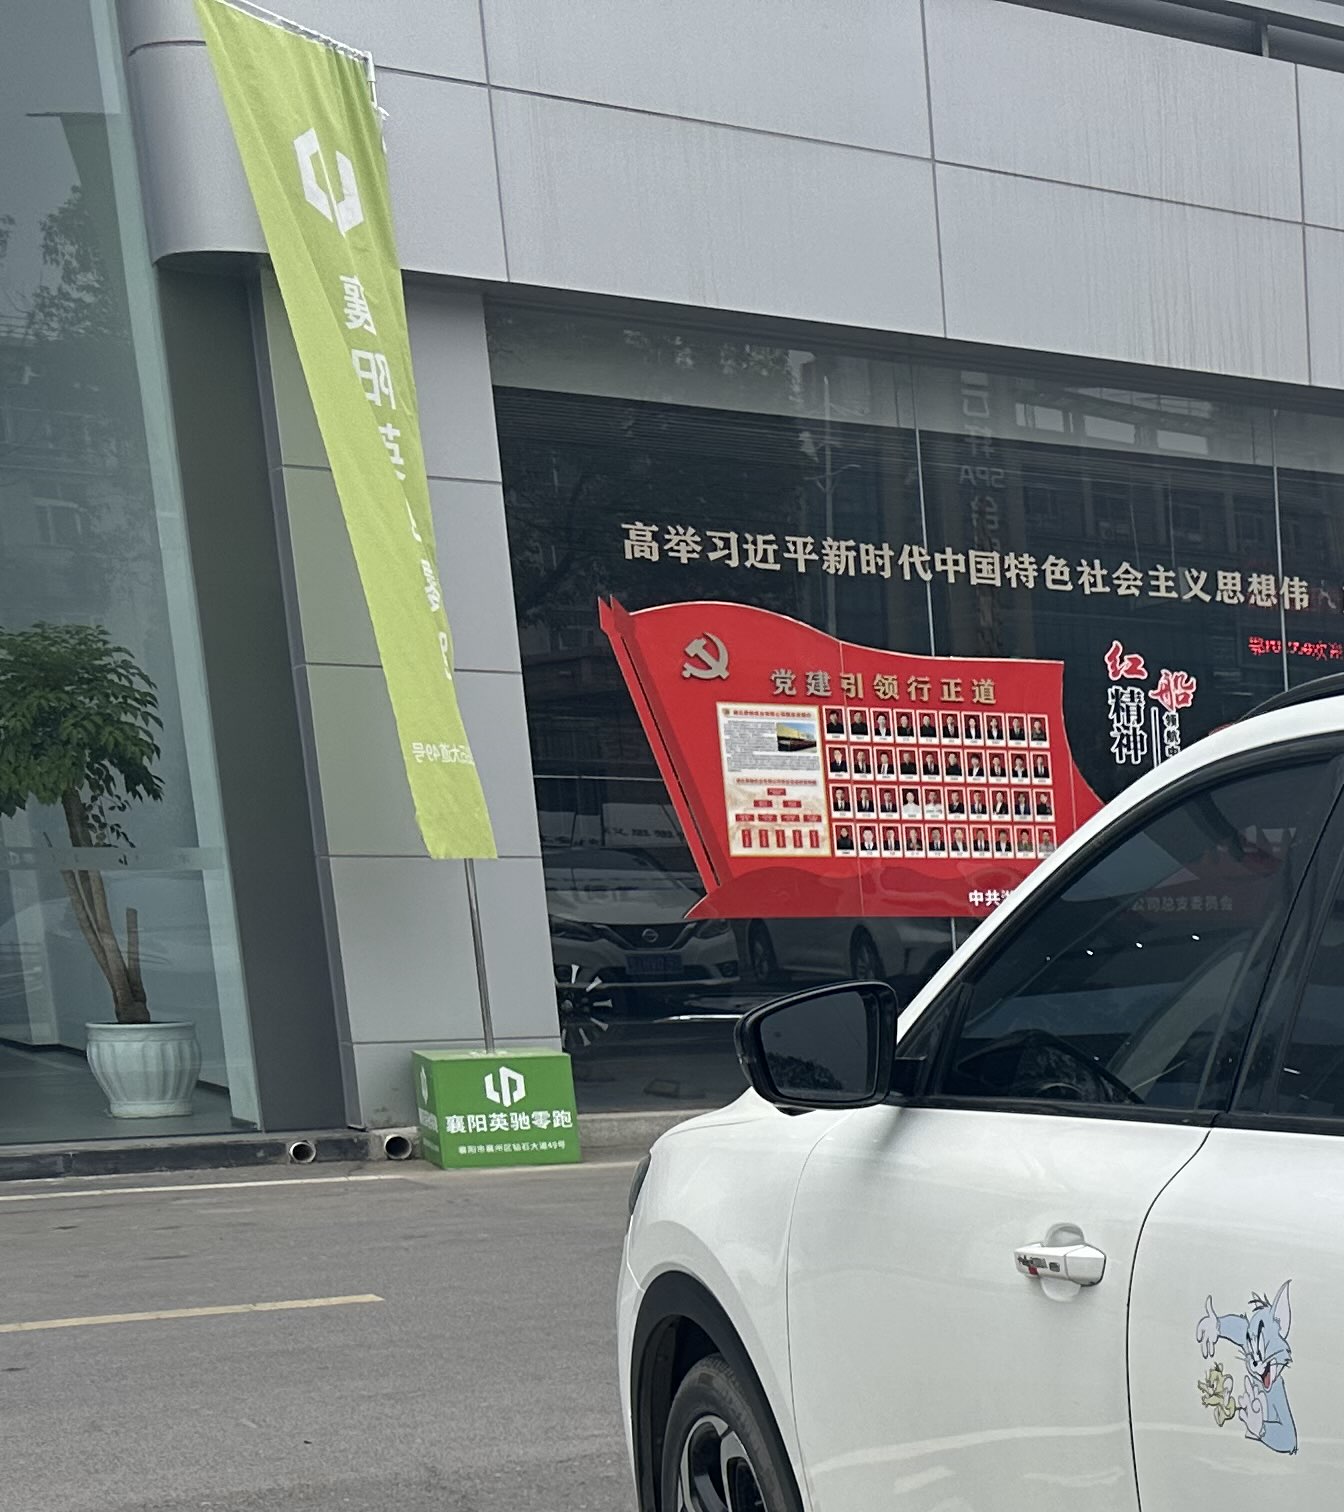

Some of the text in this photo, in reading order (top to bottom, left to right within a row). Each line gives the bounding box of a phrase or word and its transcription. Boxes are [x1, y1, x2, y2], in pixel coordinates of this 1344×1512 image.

[770, 667, 997, 706] 党建引领行正道
[445, 1109, 573, 1134] 襄阳英驰零跑
